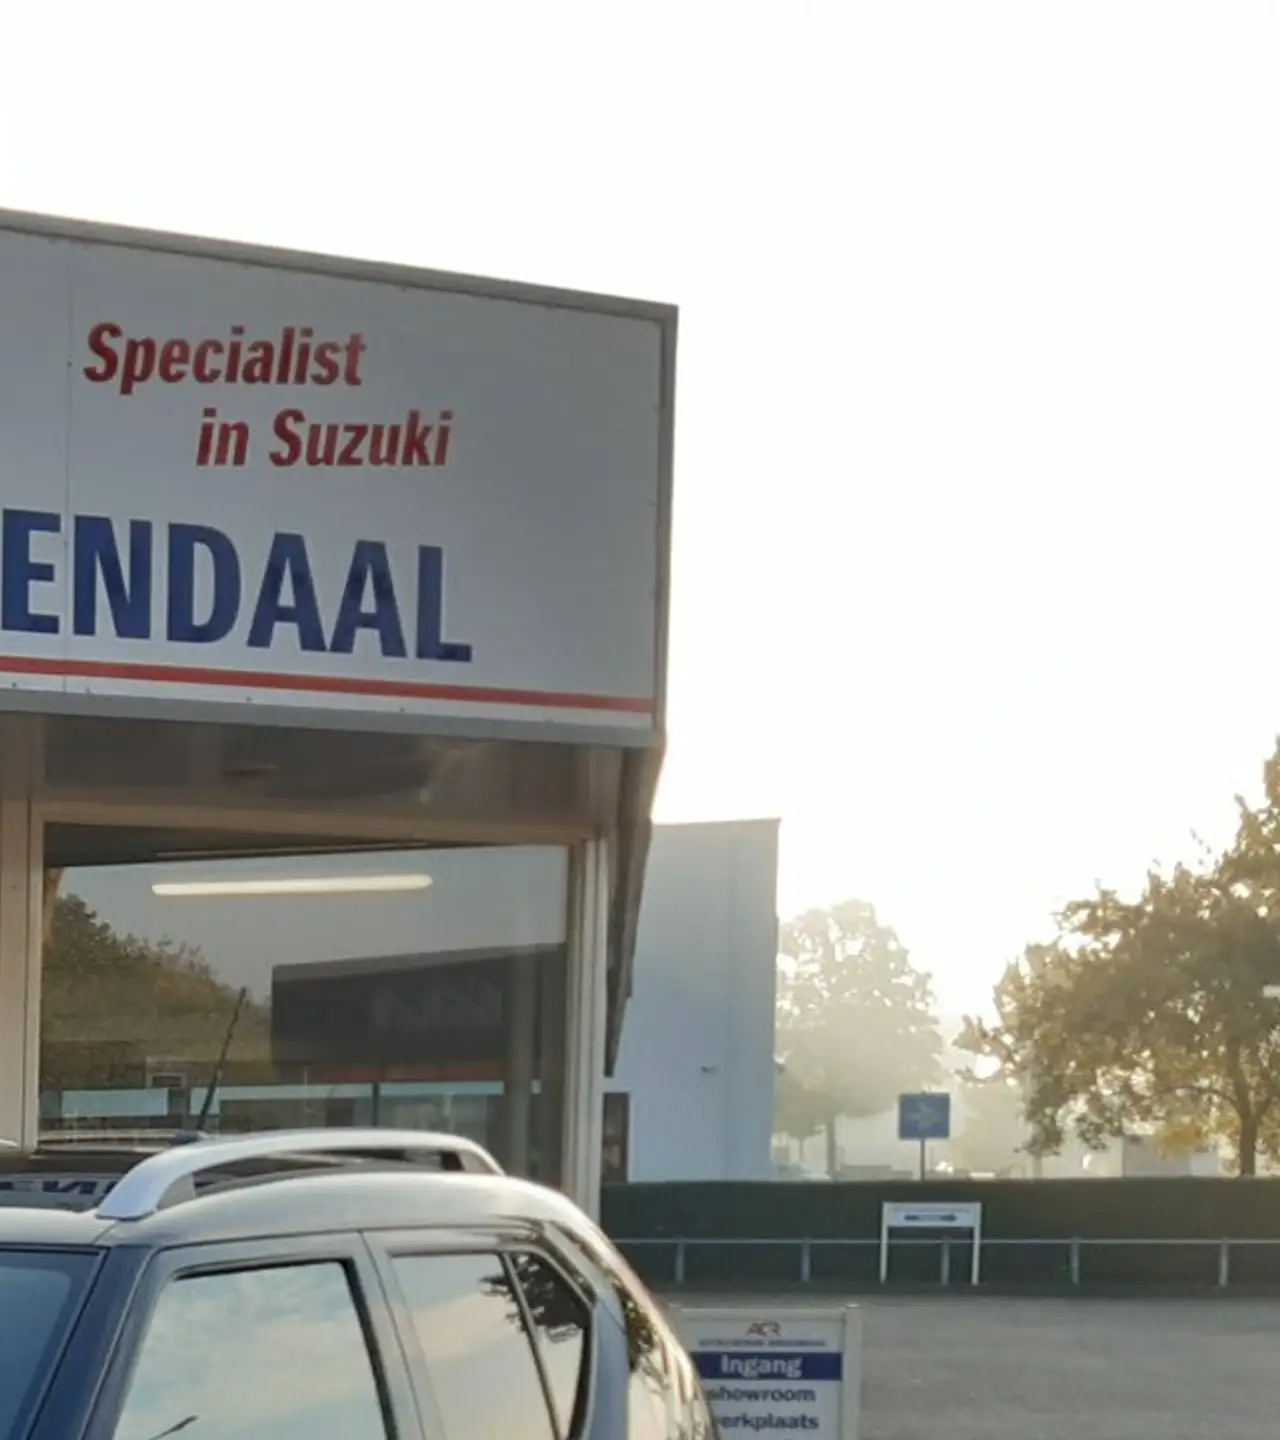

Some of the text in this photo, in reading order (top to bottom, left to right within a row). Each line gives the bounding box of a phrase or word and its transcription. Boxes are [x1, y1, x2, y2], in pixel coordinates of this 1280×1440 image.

[83, 322, 367, 396] Specialist
[195, 407, 454, 468] in Suzuki
[721, 1354, 803, 1378] Ingang
